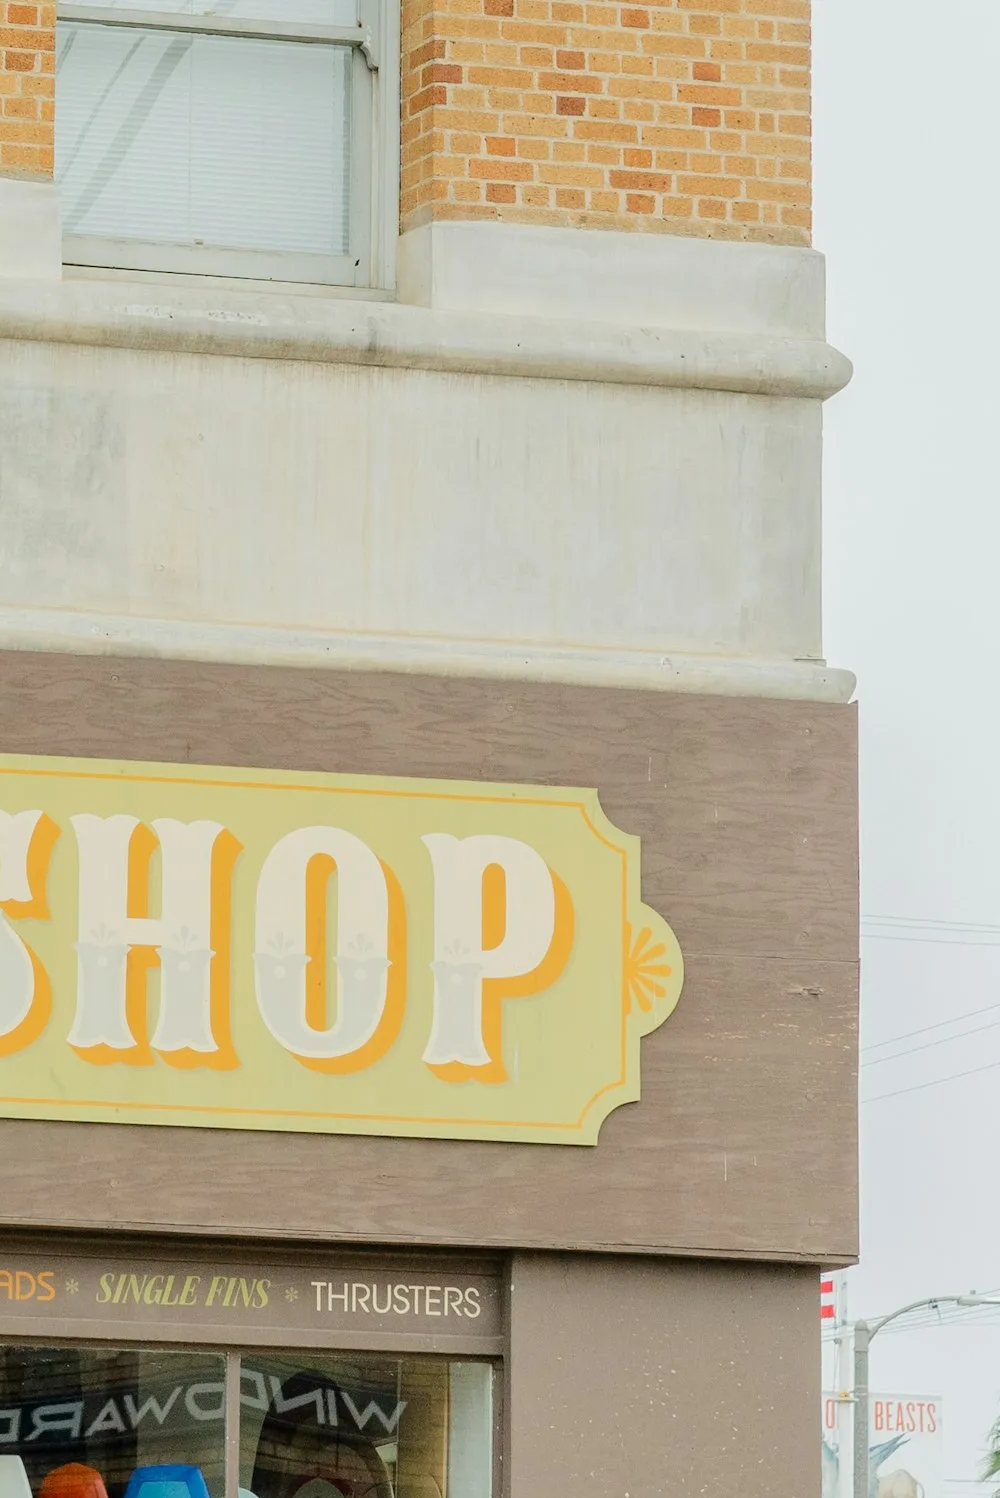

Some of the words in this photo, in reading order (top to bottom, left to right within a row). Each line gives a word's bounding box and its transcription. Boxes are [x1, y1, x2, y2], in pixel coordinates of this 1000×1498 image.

[96, 1273, 201, 1306] SINGLE
[204, 1276, 271, 1309] FINS
[311, 1281, 481, 1319] THRUSTERS
[874, 1401, 937, 1432] BEASTS
